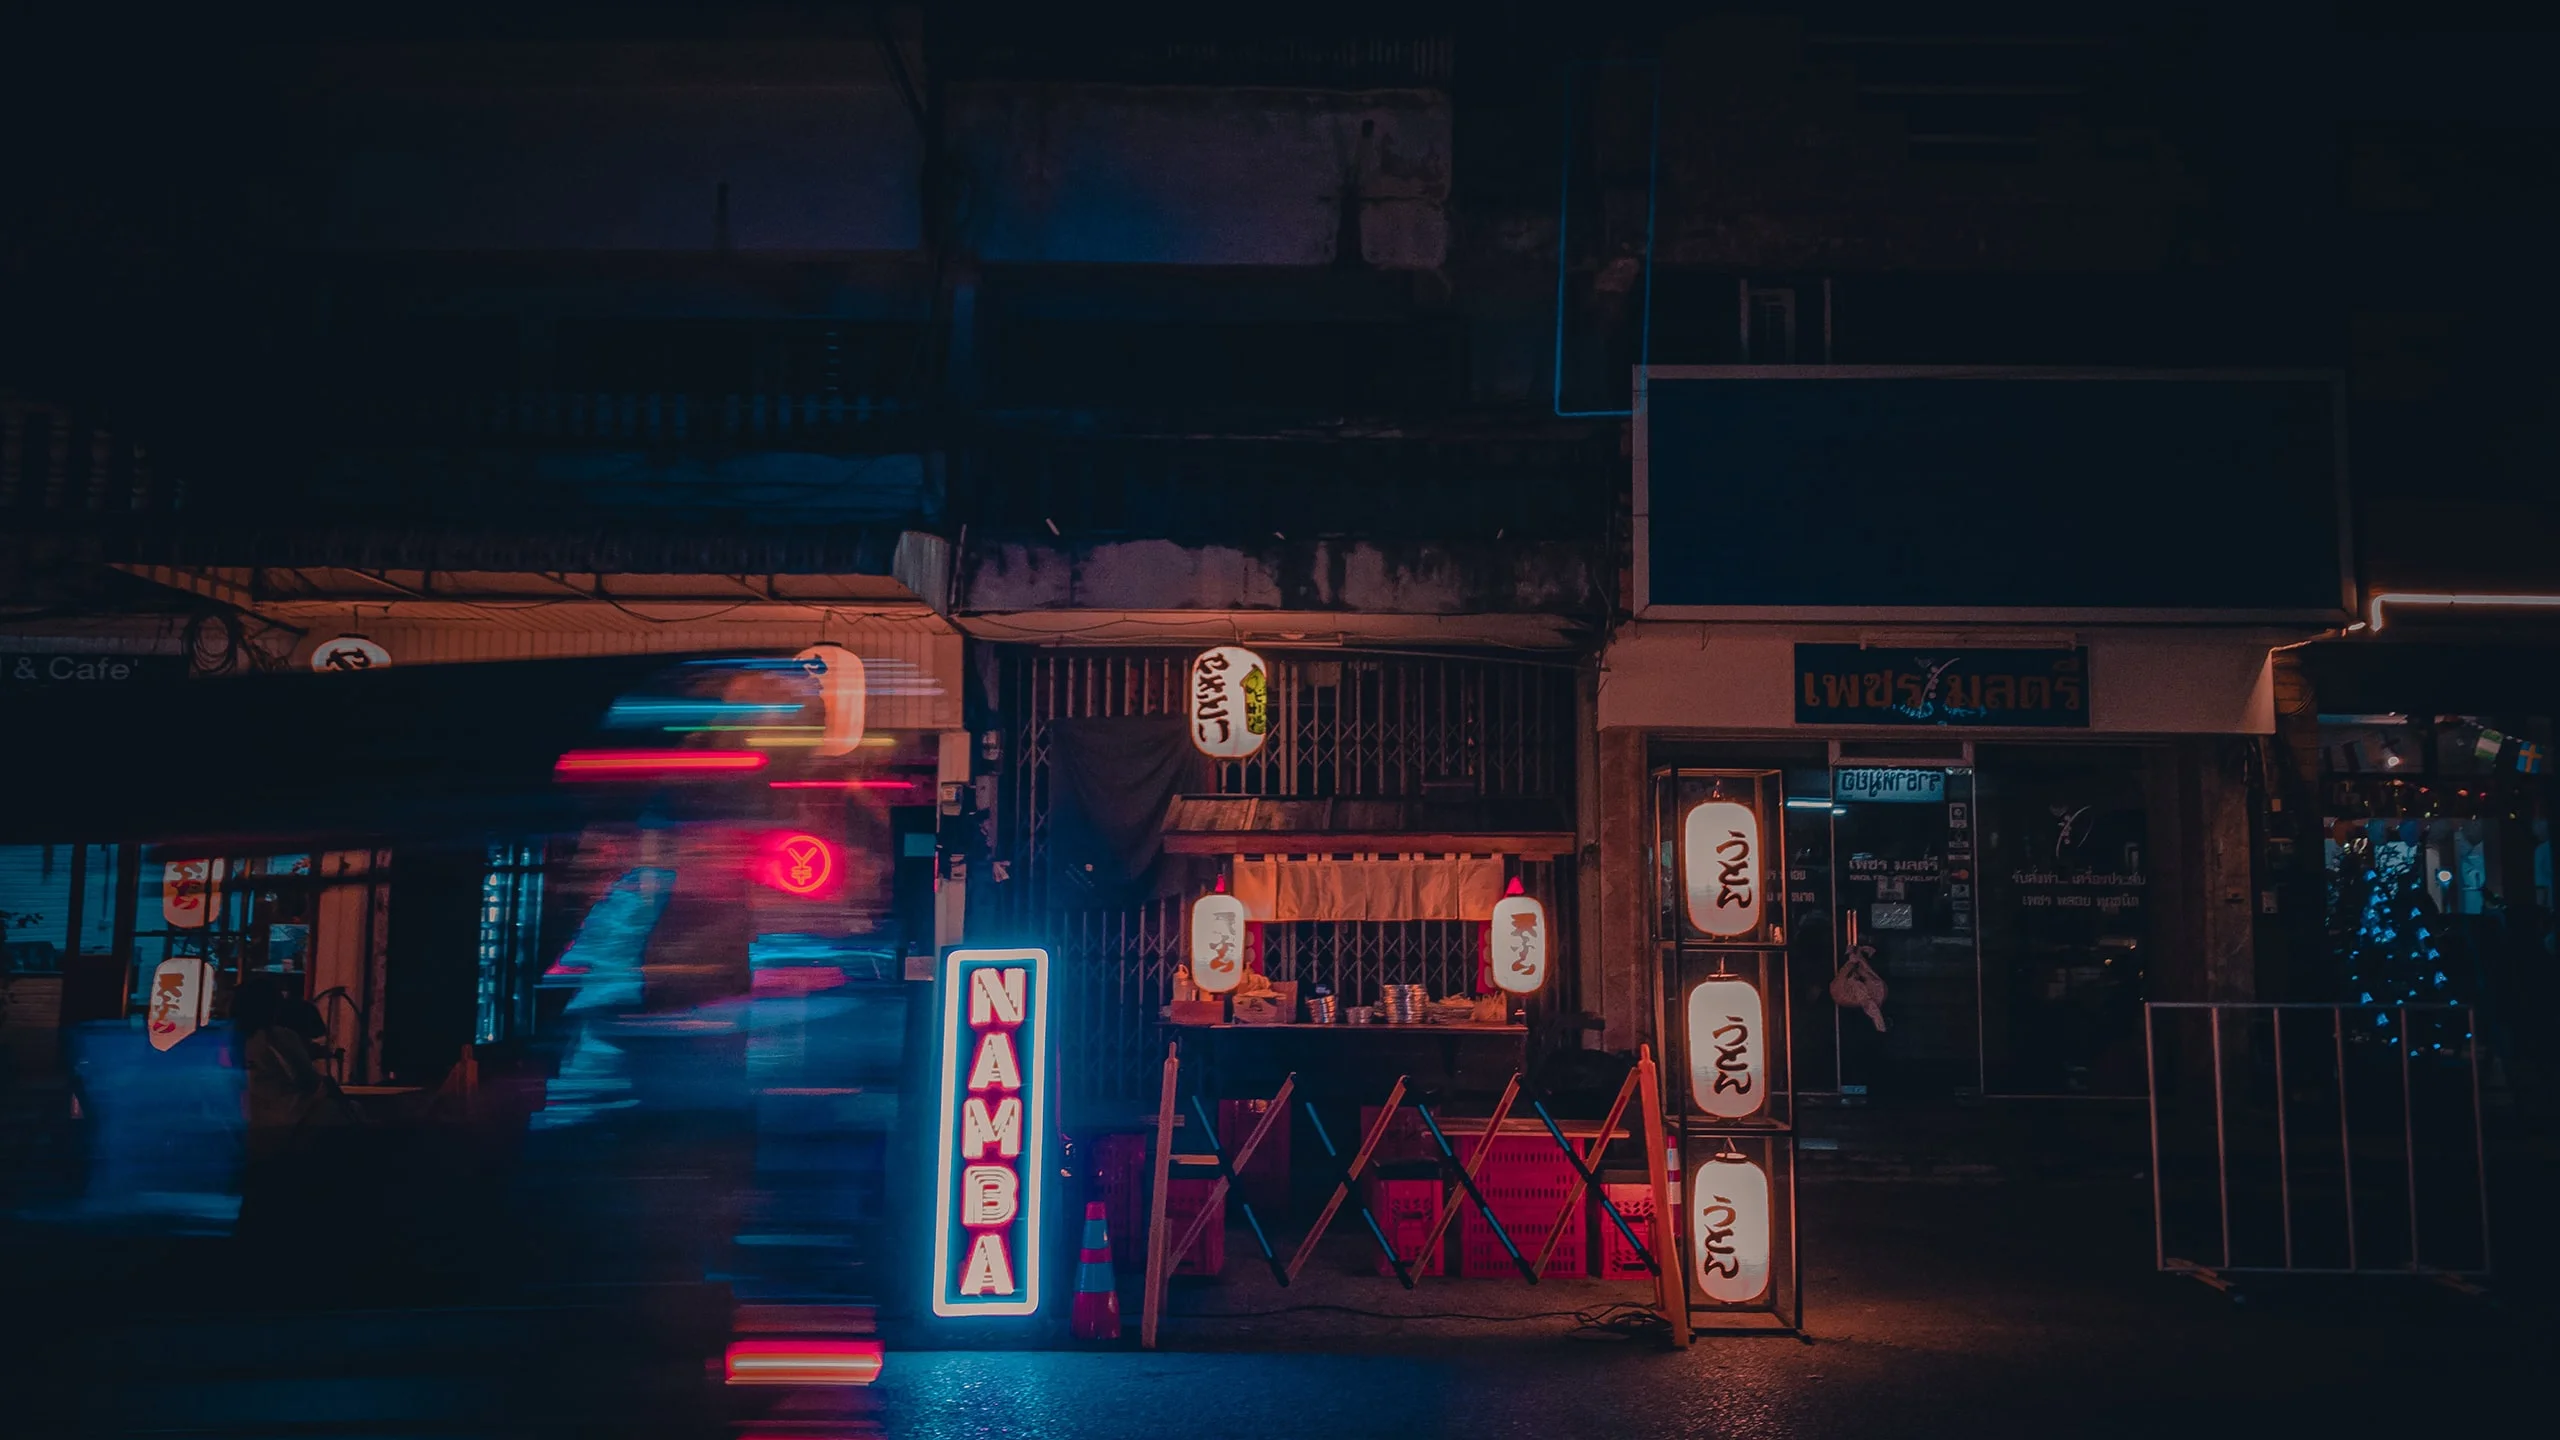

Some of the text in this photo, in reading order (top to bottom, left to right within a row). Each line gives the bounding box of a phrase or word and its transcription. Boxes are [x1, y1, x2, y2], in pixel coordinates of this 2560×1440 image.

[13, 656, 39, 680] &
[1803, 669, 1922, 709] เพชร
[960, 967, 1026, 1297] NAMBA
